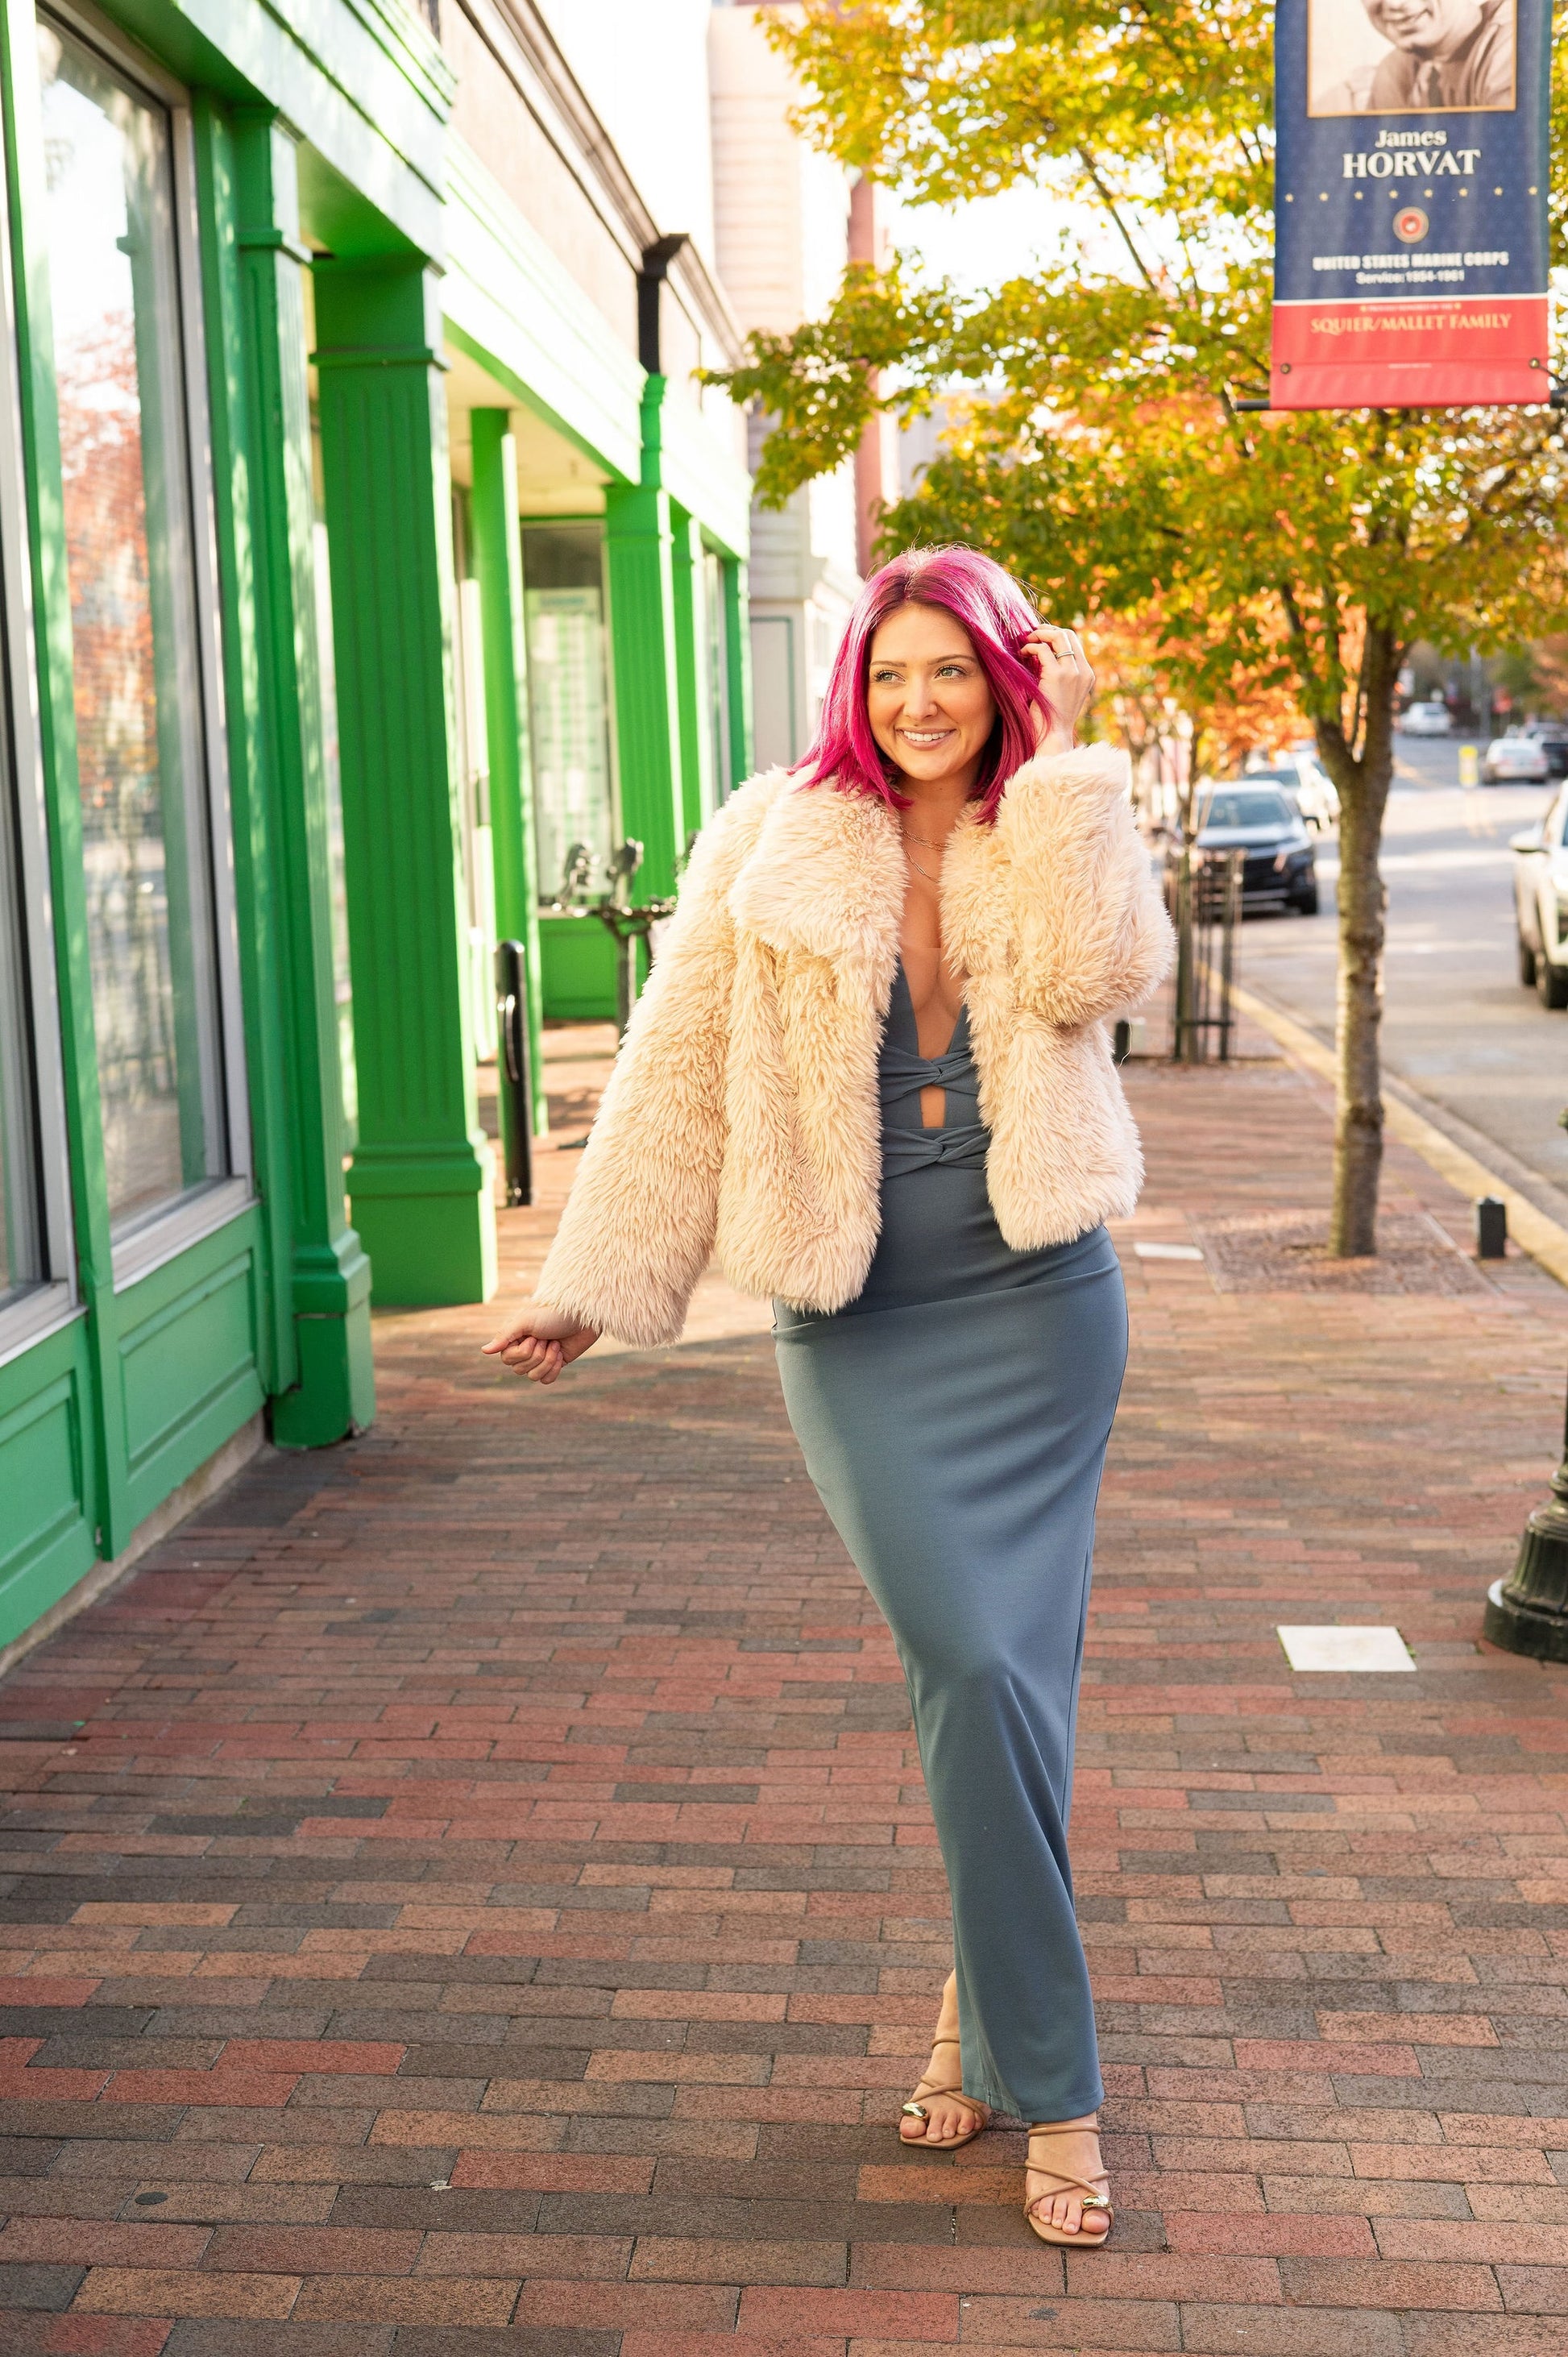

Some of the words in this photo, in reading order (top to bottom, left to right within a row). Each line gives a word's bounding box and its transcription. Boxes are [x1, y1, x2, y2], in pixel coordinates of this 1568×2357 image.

[1375, 130, 1447, 148] James
[1342, 150, 1481, 179] HORVAT
[1313, 255, 1360, 271] UNITED
[1362, 254, 1409, 269] STATES
[1411, 252, 1462, 268] MARINE
[1463, 251, 1509, 266] CORPS
[1311, 315, 1445, 335] SQUIER/MALLET
[1450, 313, 1512, 330] FAMILY
